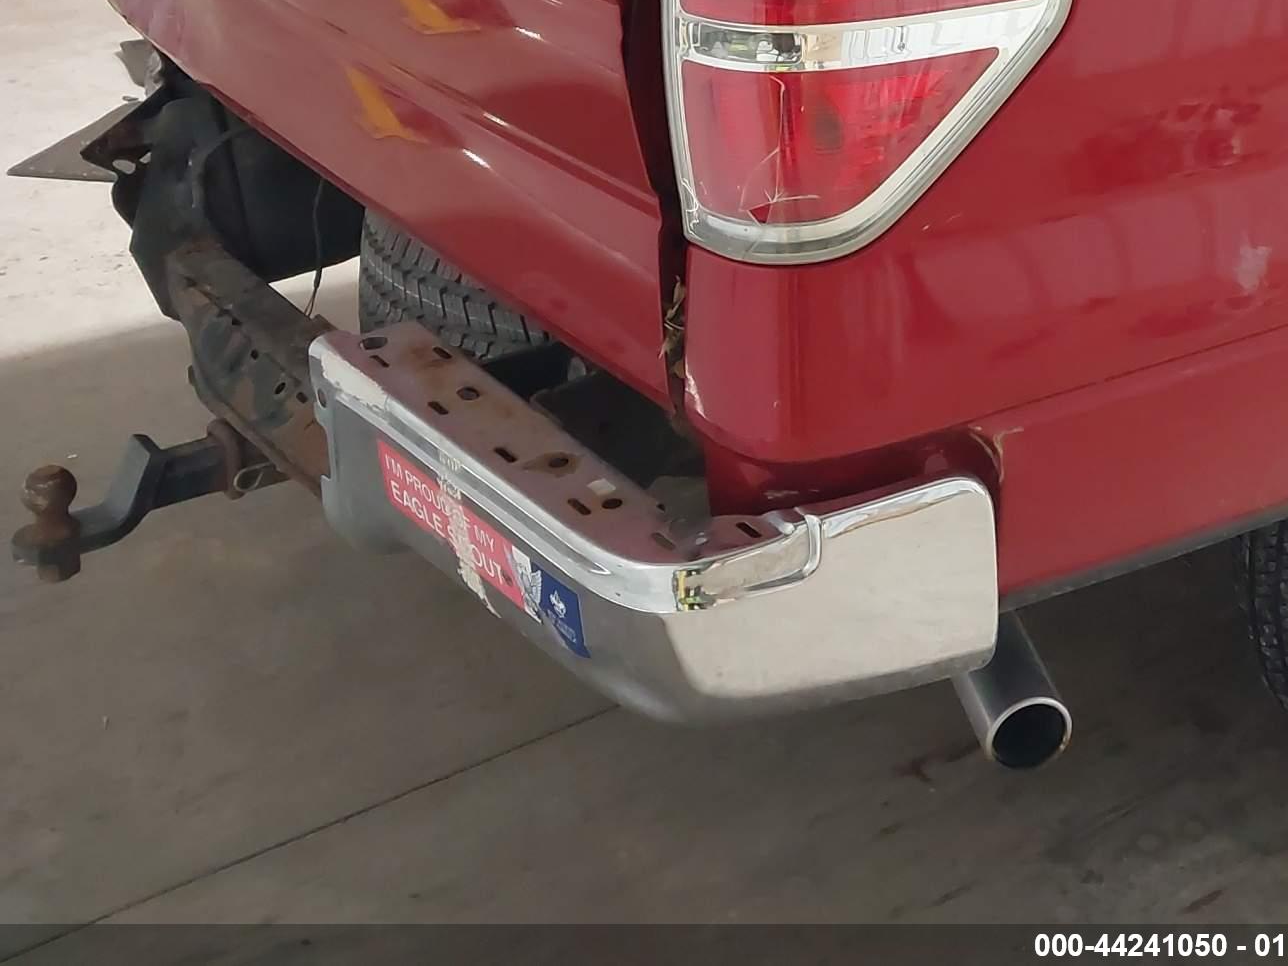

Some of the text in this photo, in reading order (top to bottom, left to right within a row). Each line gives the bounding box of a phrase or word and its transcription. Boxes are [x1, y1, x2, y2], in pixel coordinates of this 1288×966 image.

[385, 453, 403, 480] I'M
[474, 524, 496, 553] MY
[390, 479, 447, 539] EAGLE
